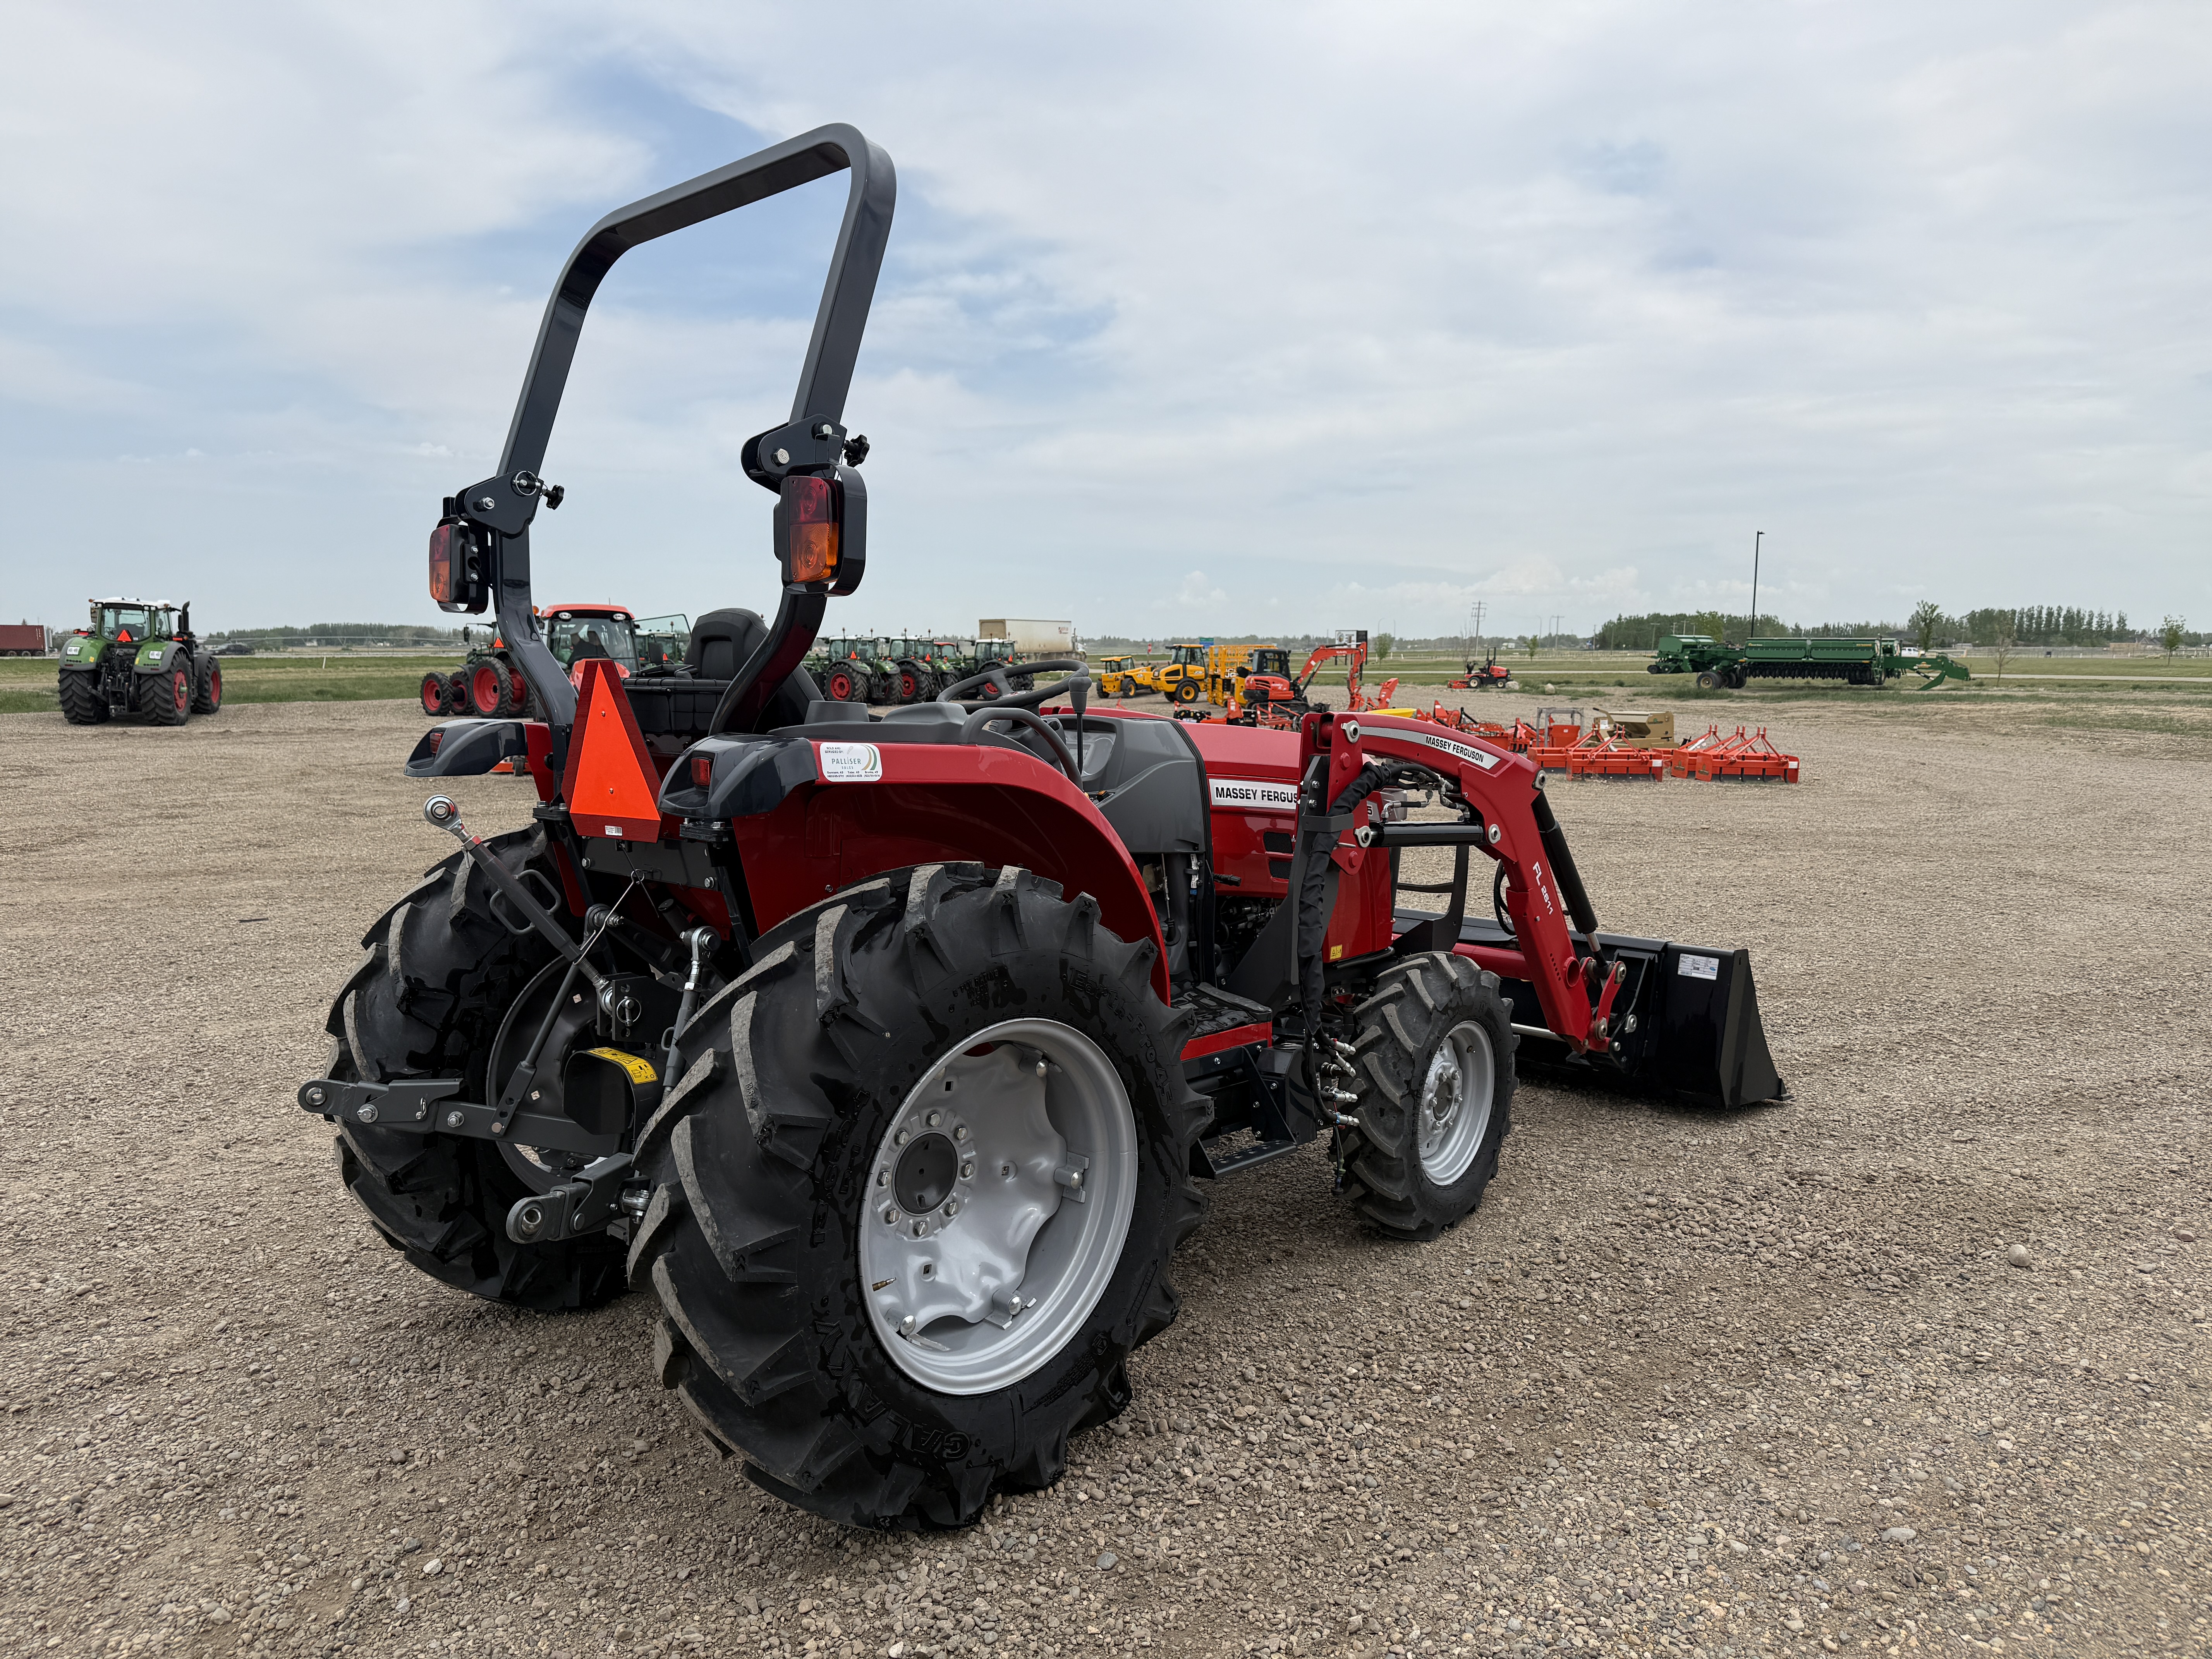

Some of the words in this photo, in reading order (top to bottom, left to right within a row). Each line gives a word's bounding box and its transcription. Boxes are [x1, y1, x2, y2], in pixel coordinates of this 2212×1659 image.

[1425, 736, 1452, 750] MASSEY
[1452, 744, 1484, 763] FERGUSON
[1216, 787, 1257, 800] MASSEY
[1533, 861, 1542, 886] FL
[959, 979, 973, 993] PLY
[974, 969, 999, 987] RATING
[1069, 968, 1157, 1063] Earth-Pro
[1155, 1067, 1172, 1106] 45
[814, 1320, 971, 1460] GALAXY
